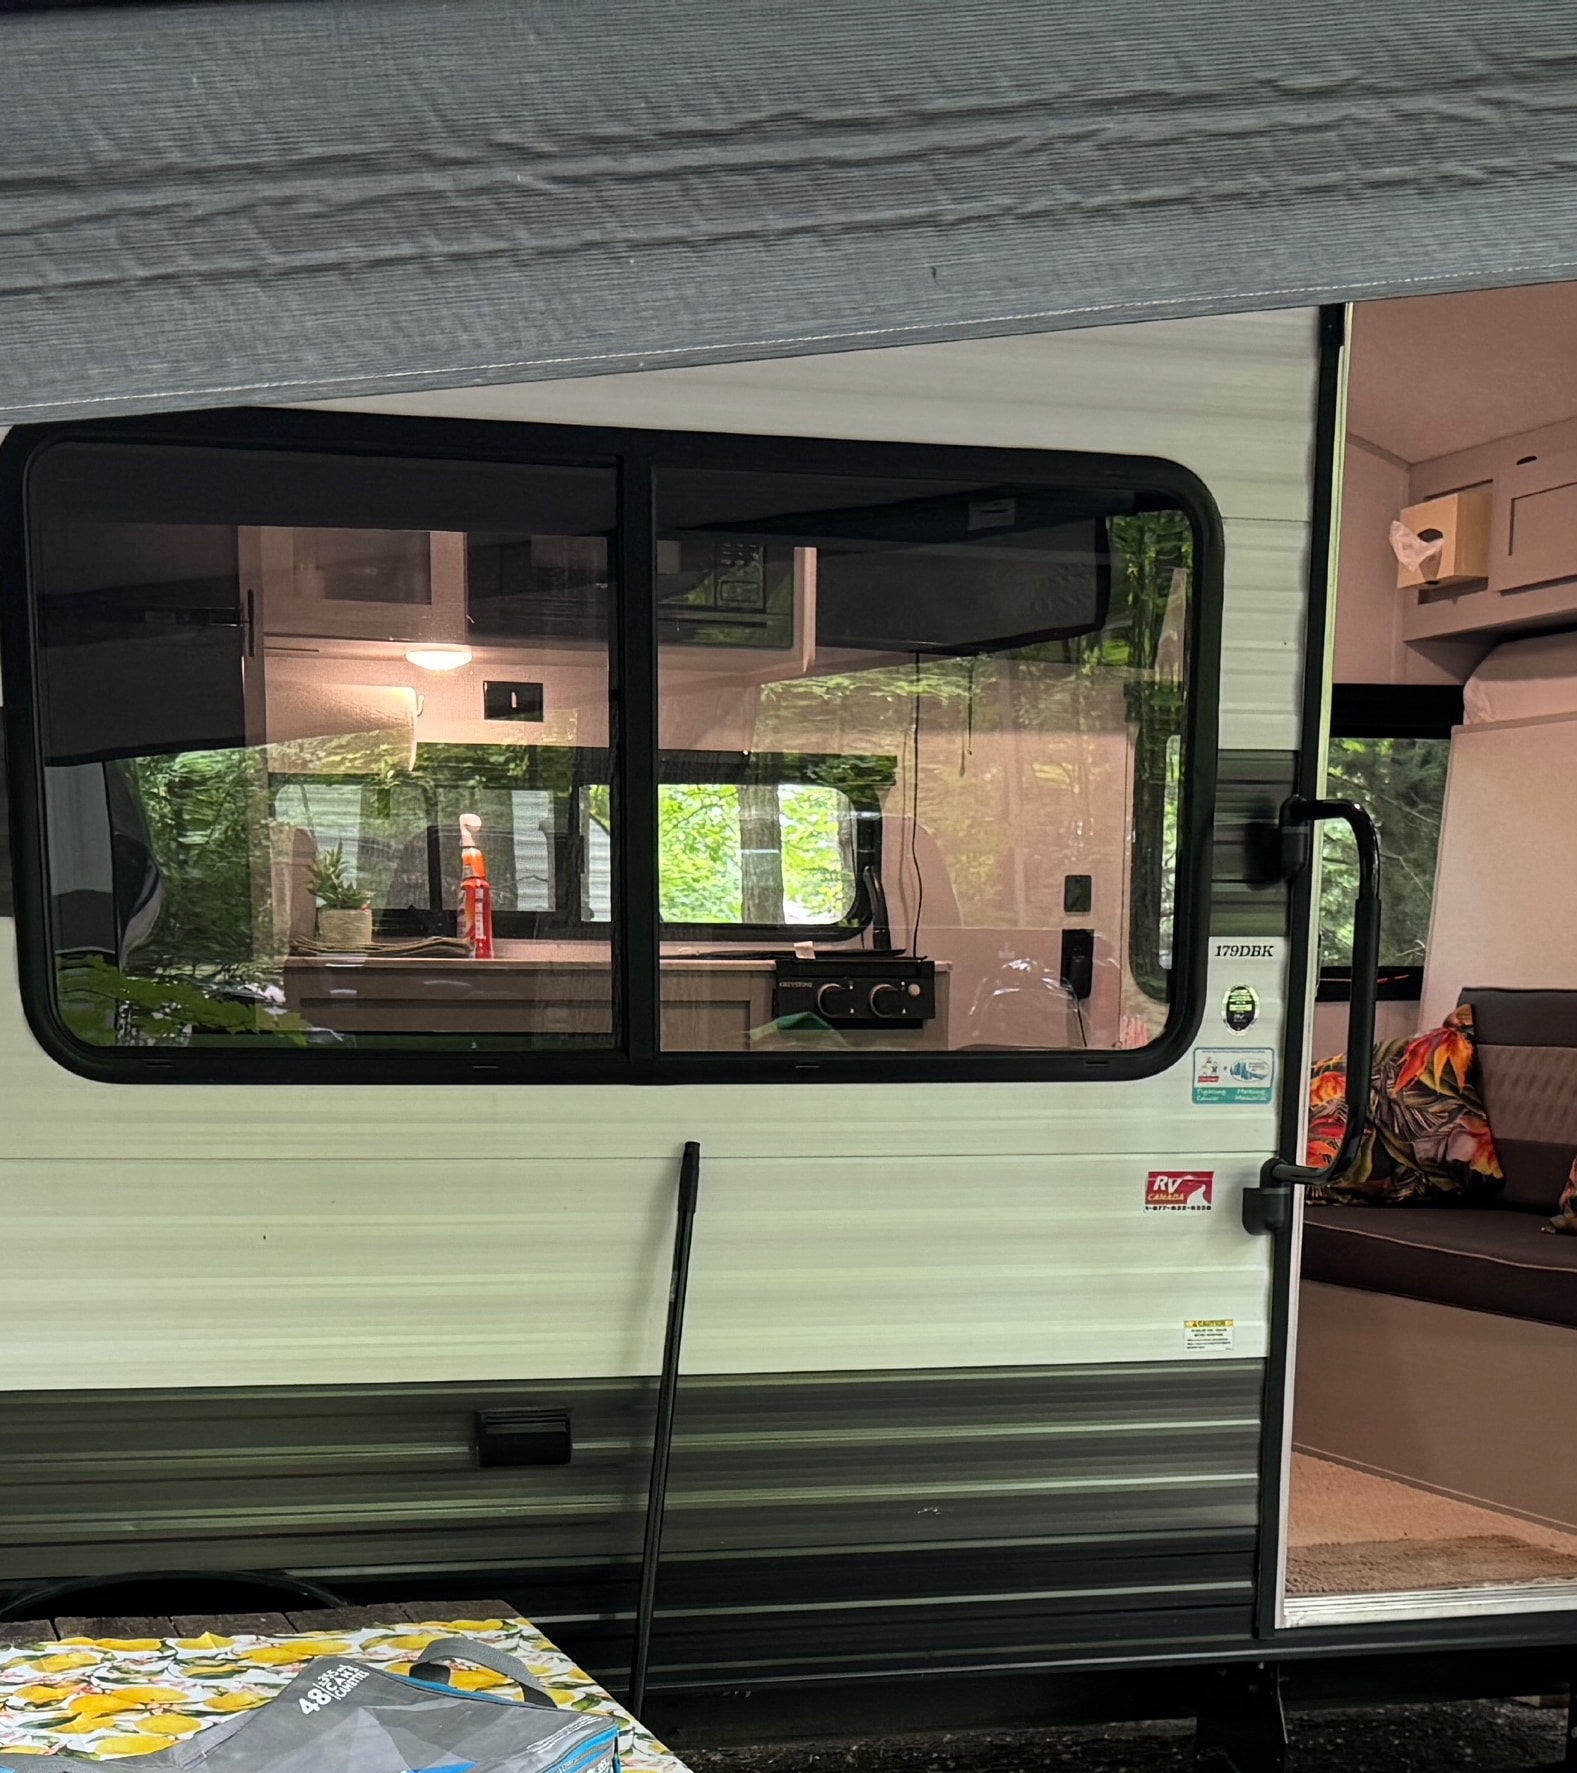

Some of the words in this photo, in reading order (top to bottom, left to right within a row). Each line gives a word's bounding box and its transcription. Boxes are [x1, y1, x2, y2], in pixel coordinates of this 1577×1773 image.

[1215, 945, 1274, 957] 179DBK
[1152, 1175, 1184, 1194] RV
[1147, 1193, 1185, 1201] CANADA
[299, 1688, 332, 1715] 48
